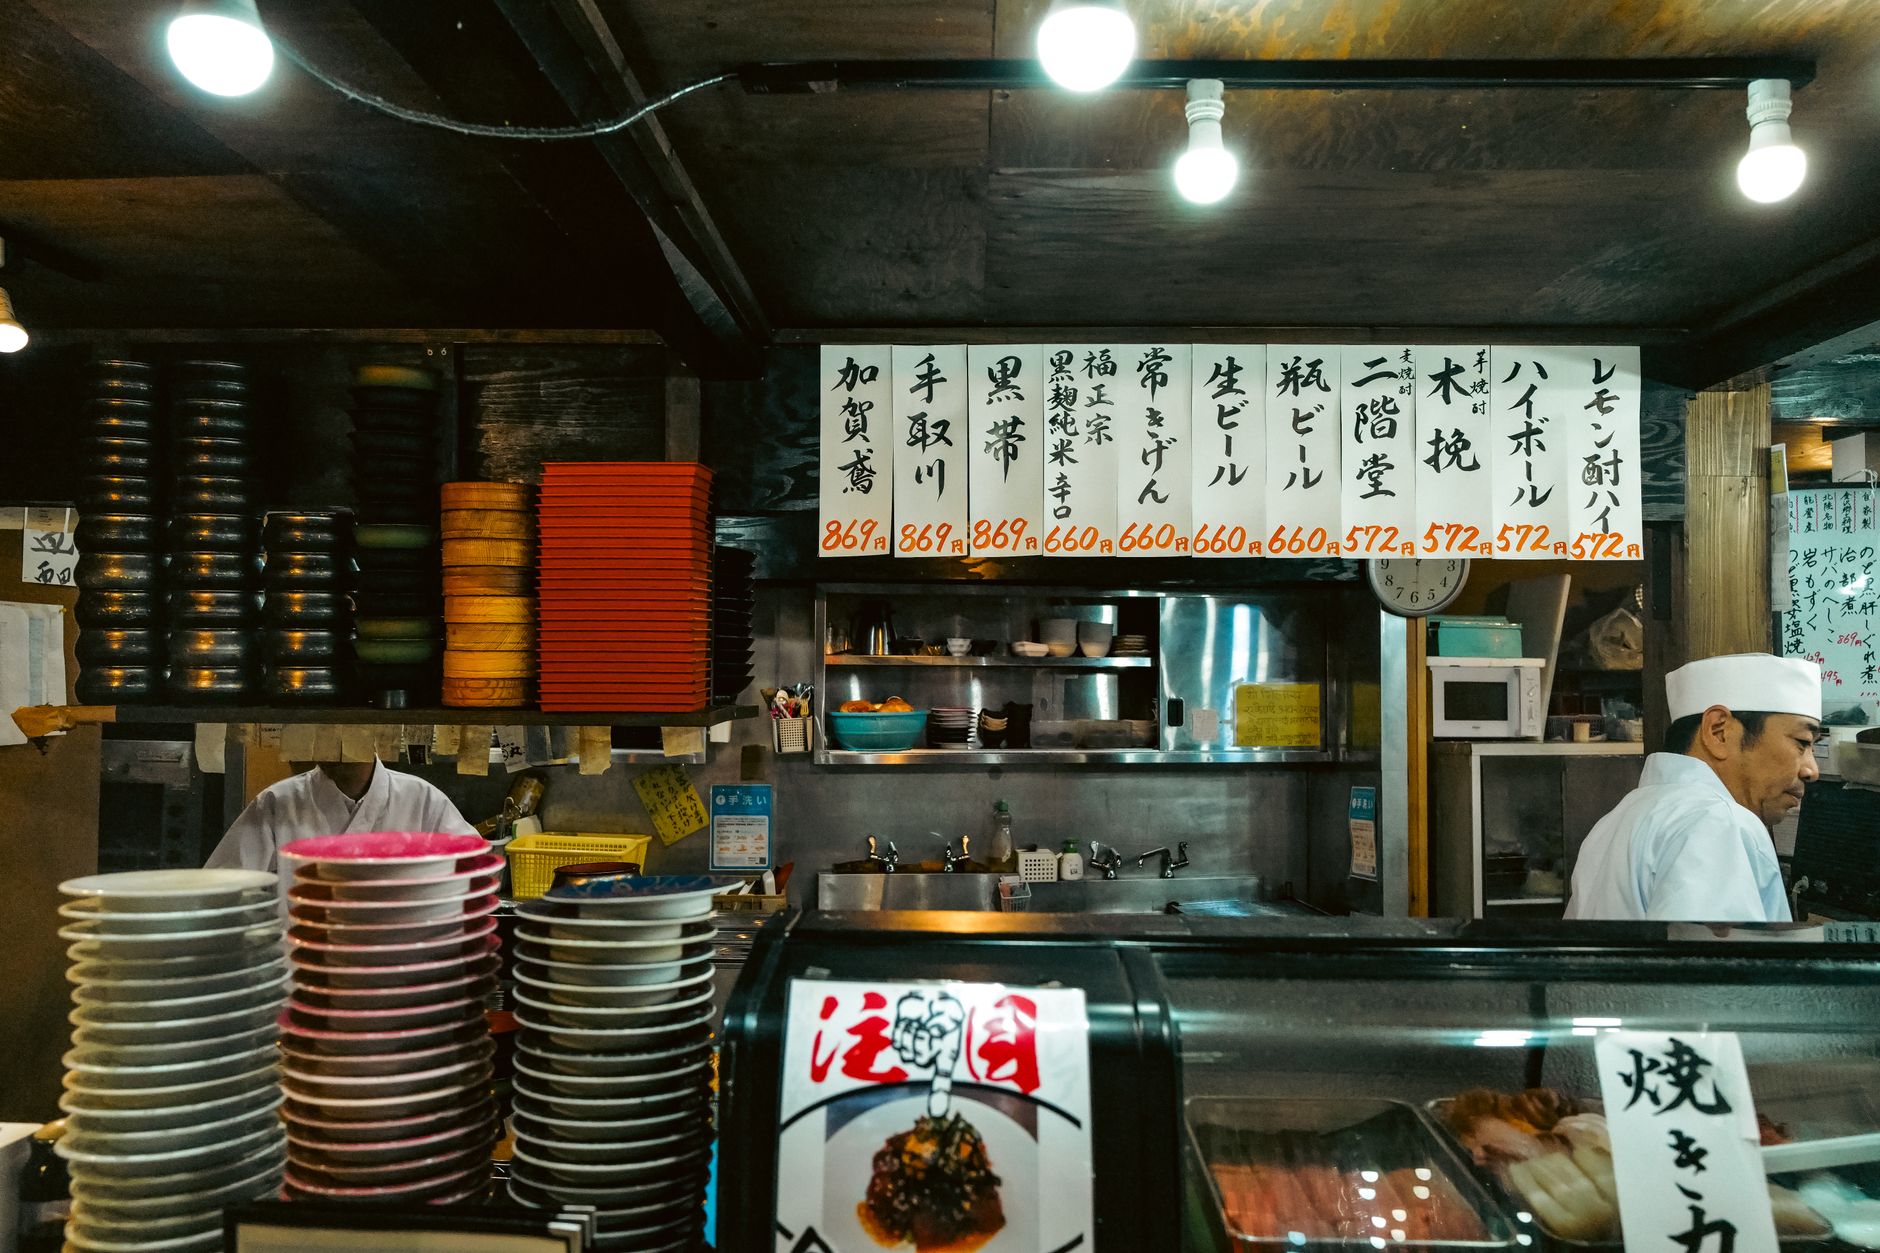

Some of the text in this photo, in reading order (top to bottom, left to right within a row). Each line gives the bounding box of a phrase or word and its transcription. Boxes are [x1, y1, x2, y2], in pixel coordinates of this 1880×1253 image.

[1398, 348, 1415, 396] 麦焼酎
[1469, 349, 1489, 415] 芋焼酎
[1080, 348, 1117, 446] 福正宗
[831, 357, 879, 494] 加賀鳶
[906, 353, 953, 501] 手取川
[984, 355, 1026, 483] 黒帯
[1137, 347, 1178, 505] 常きげん
[1203, 356, 1249, 488] 生ビール
[1276, 356, 1332, 491] 瓶ビール
[1351, 356, 1400, 499] 二階堂
[1423, 357, 1480, 474] 木挽
[1502, 361, 1555, 508] ハイボール
[1583, 358, 1624, 535] レモン酎ハイ
[821, 518, 887, 552] 869円
[898, 522, 963, 554] 869円
[973, 517, 1038, 551] 869円
[1044, 525, 1113, 554] 660円
[1118, 523, 1189, 552] 660円
[1192, 524, 1263, 555] 660円
[1268, 525, 1341, 556] 660円
[1343, 525, 1415, 557] 572円
[1423, 523, 1493, 556] 572円
[1497, 524, 1568, 555] 572円
[1571, 532, 1641, 560] 572円
[1381, 559, 1389, 569] 9
[1385, 575, 1393, 586] 8
[1447, 559, 1455, 571] 3
[1396, 587, 1404, 599] 7
[1410, 591, 1419, 603] 6
[1427, 589, 1435, 600] 5
[1440, 576, 1447, 587] 4
[1802, 548, 1820, 631] 岩もずく
[728, 794, 767, 806] 手洗い
[811, 991, 1040, 1095] 注目
